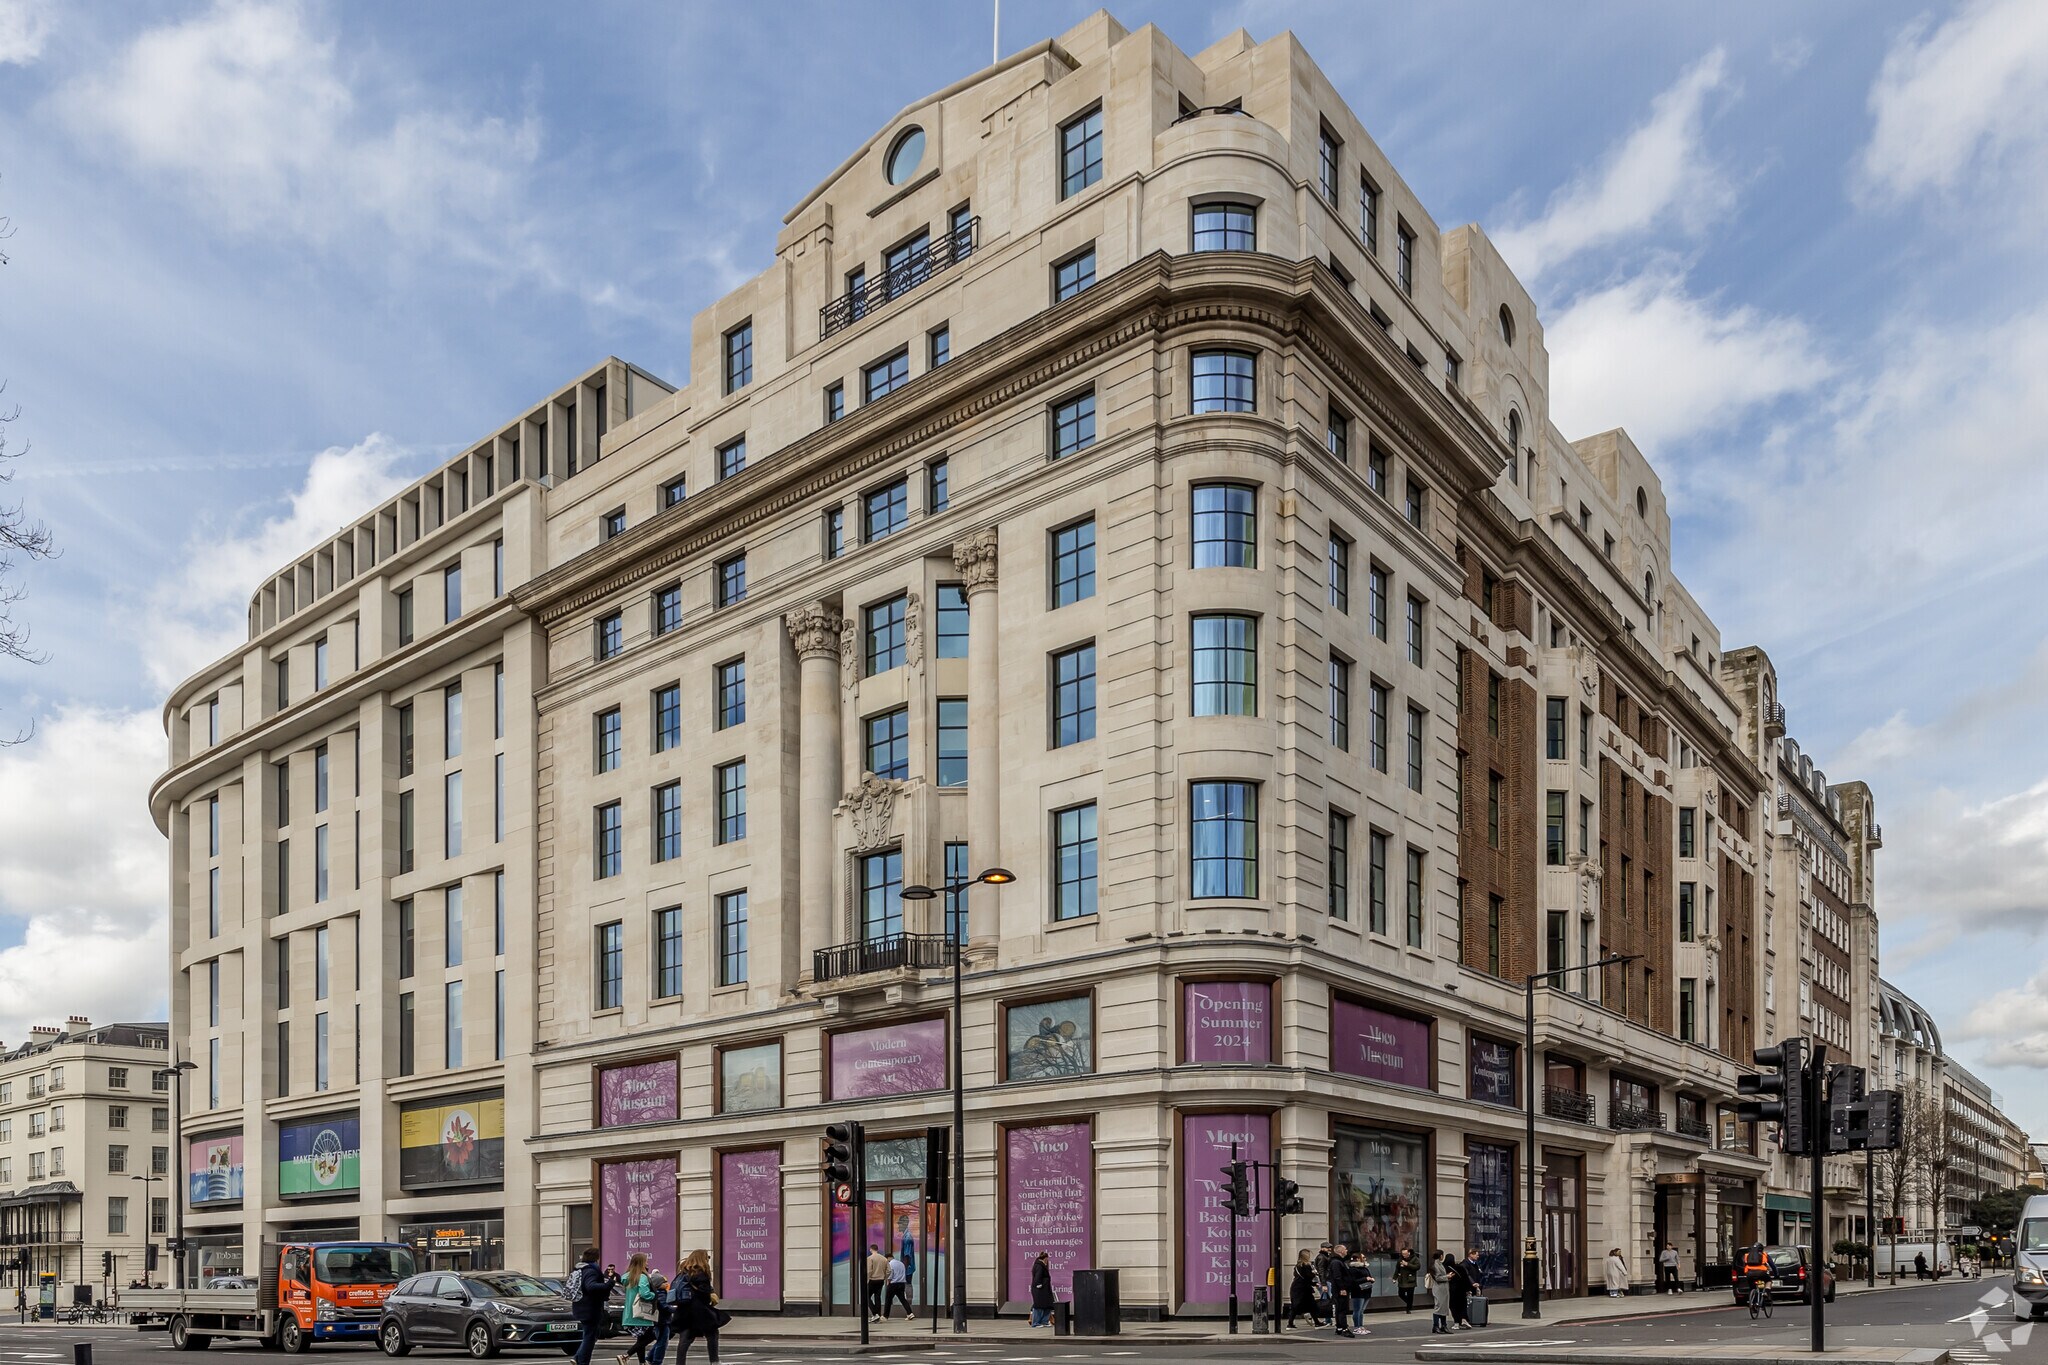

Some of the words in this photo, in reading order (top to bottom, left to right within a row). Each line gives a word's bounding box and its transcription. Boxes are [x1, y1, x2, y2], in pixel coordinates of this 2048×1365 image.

[1200, 998, 1263, 1013] Opening
[1200, 1016, 1262, 1029] Summer
[1214, 1035, 1251, 1047] 2024
[1369, 1025, 1396, 1046] Moco
[870, 1040, 907, 1052] Modern
[854, 1054, 922, 1070] Contemporary
[1361, 1044, 1404, 1069] Museum
[881, 1073, 896, 1083] Art
[626, 1079, 657, 1093] Moco
[616, 1095, 666, 1111] Museum
[1205, 1130, 1255, 1143] Moco
[1032, 1141, 1069, 1153] Moco
[1371, 1141, 1391, 1155] Moco
[293, 1154, 311, 1164] MAKE
[873, 1154, 904, 1166] Moco
[739, 1164, 766, 1176] Moco
[1039, 1177, 1068, 1187] should
[1070, 1175, 1081, 1185] be
[1018, 1189, 1062, 1199] something
[1065, 1188, 1082, 1197] that
[738, 1204, 766, 1213] Warhol
[1021, 1202, 1057, 1211] liberates
[1060, 1202, 1080, 1211] your
[1476, 1203, 1500, 1218] Opening
[627, 1217, 652, 1227] Haring
[738, 1216, 766, 1226] Haring
[435, 1228, 465, 1237] Sainsbury's
[1017, 1226, 1031, 1234] the
[1032, 1224, 1084, 1235] imagination
[1476, 1222, 1500, 1233] Summer
[625, 1228, 654, 1239] Basquiat
[736, 1228, 768, 1239] Basquiat
[435, 1238, 450, 1247] Local
[628, 1239, 650, 1249] Koons
[740, 1240, 764, 1249] Koons
[1017, 1238, 1033, 1246] and
[1034, 1237, 1083, 1247] encourages
[1201, 1242, 1257, 1253] Kusma
[737, 1252, 767, 1261] Kusama
[1024, 1249, 1052, 1259] peole
[1065, 1250, 1076, 1260] go
[742, 1263, 762, 1272] Kaws
[739, 1275, 765, 1287] Digital
[1205, 1271, 1254, 1286] Digtal
